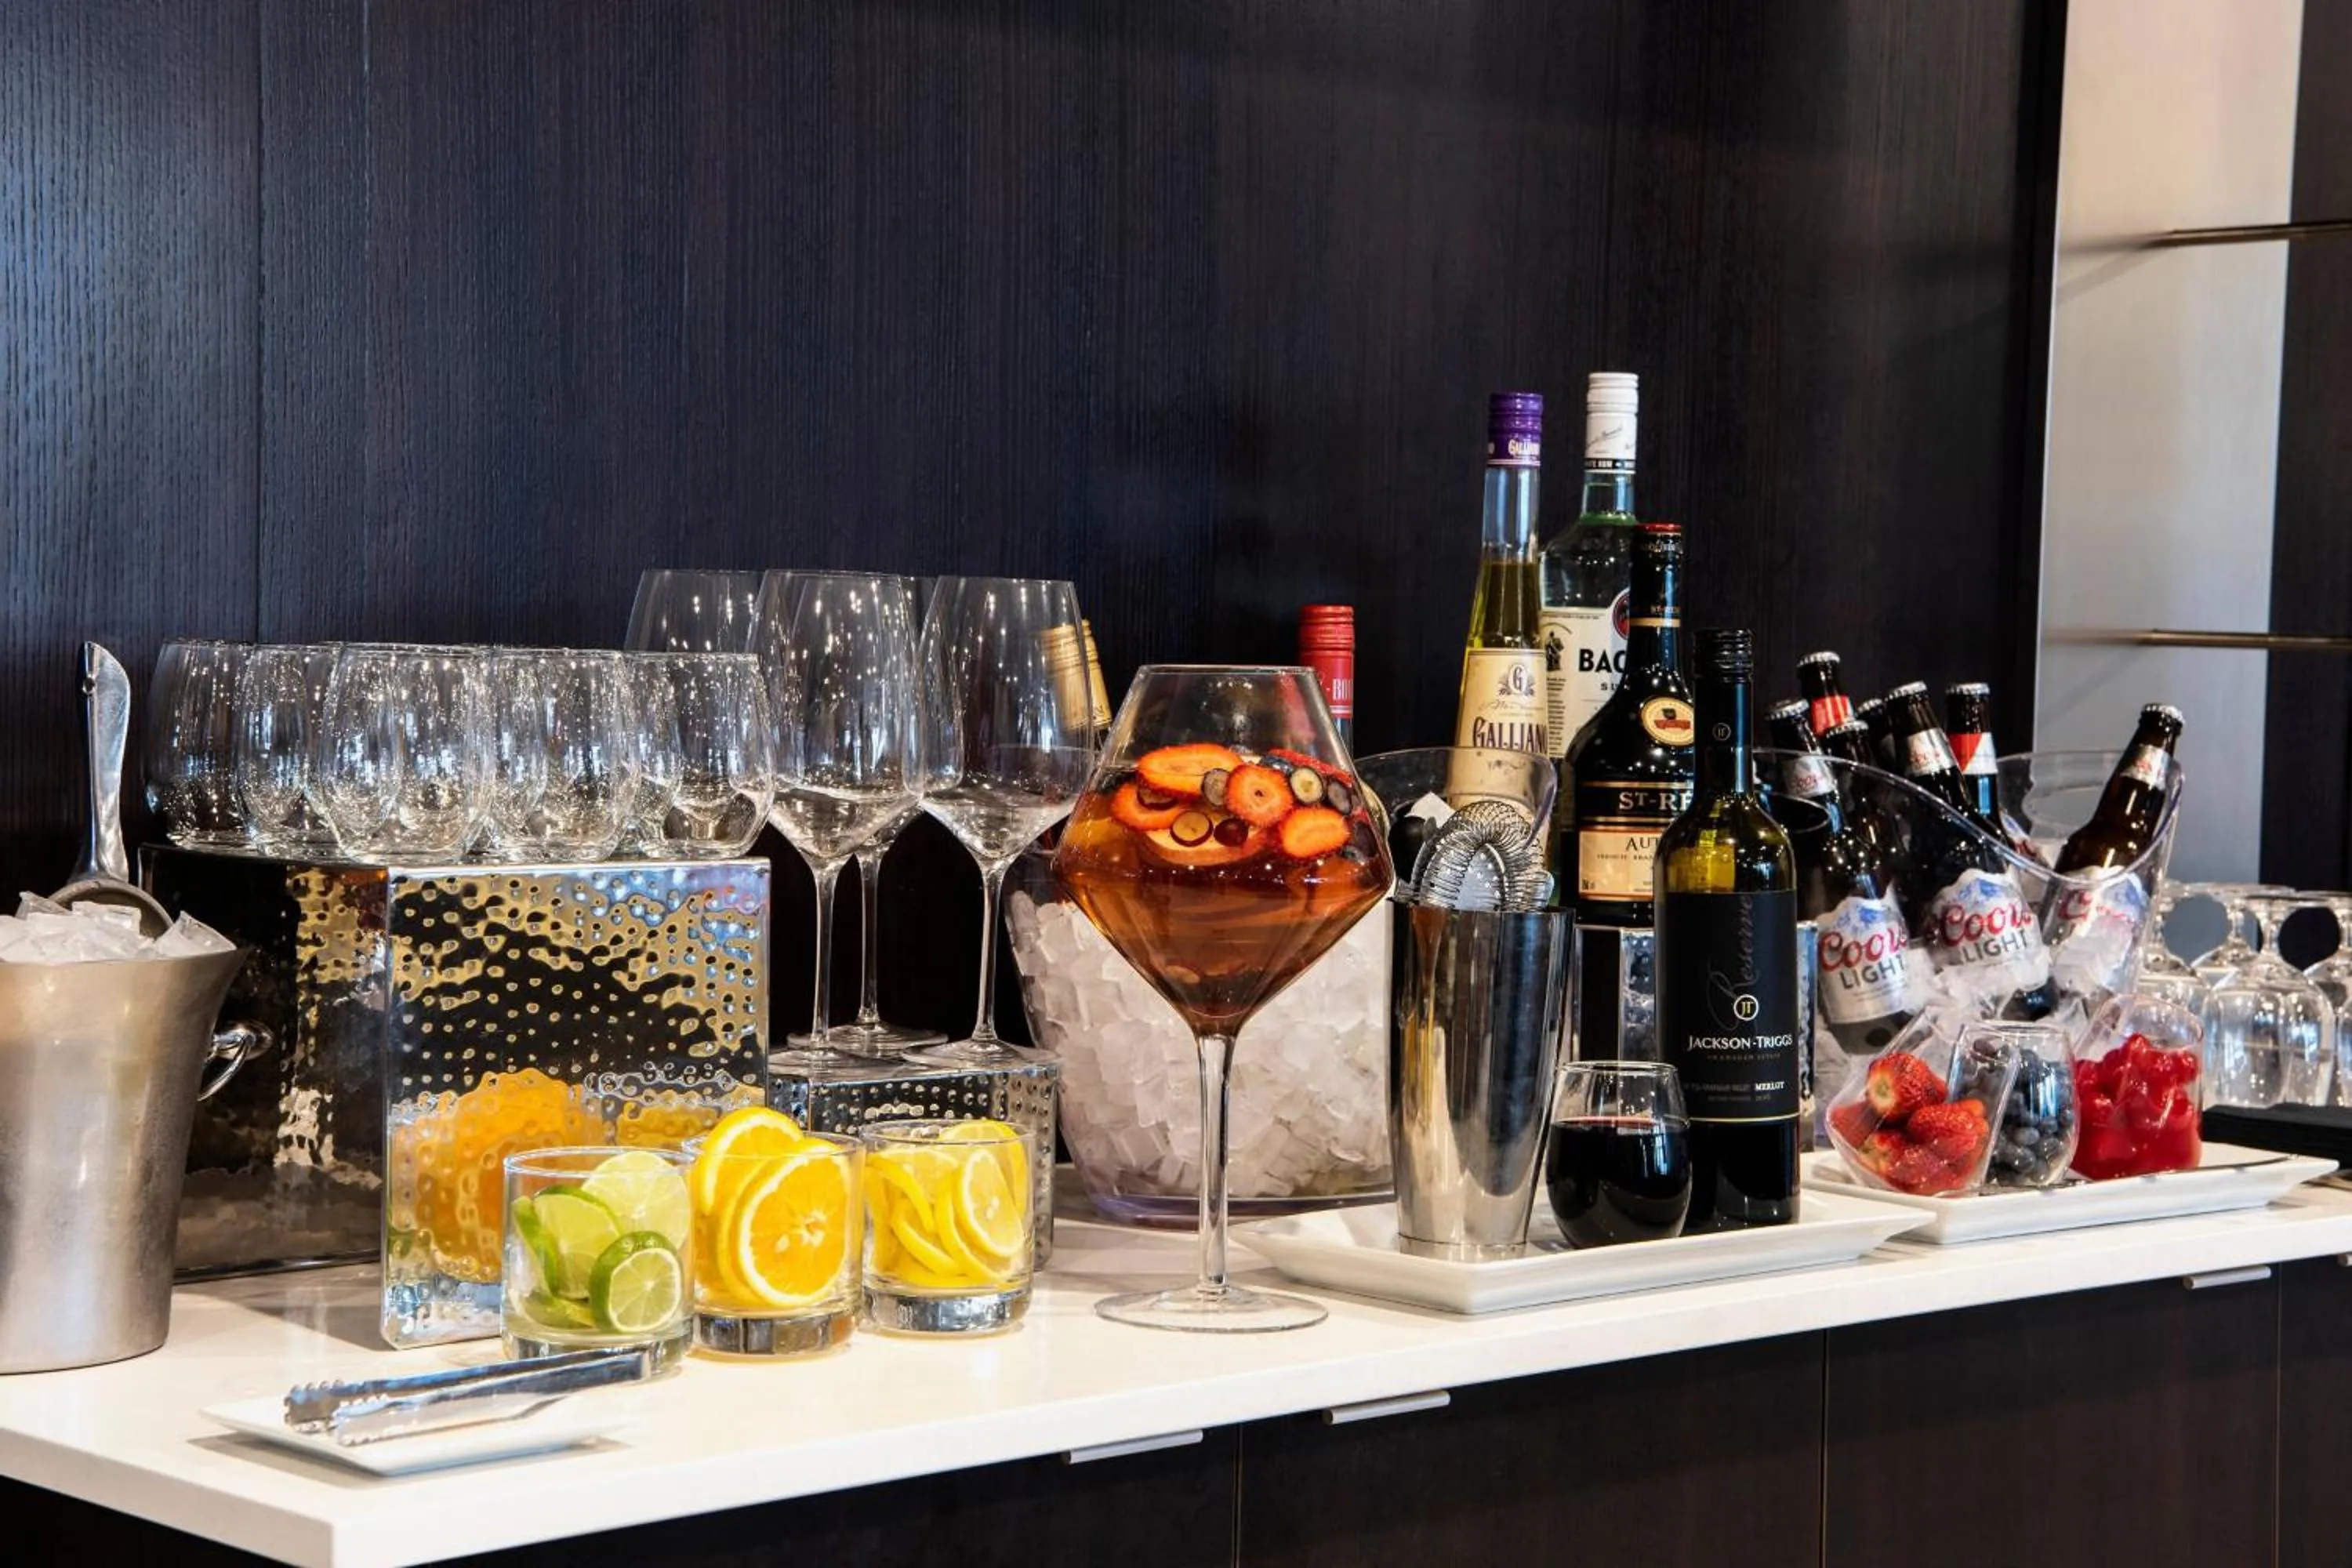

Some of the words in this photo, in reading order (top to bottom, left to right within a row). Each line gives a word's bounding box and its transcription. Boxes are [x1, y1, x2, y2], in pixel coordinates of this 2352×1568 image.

[1962, 928, 2027, 963] LIGHT
[1840, 954, 1905, 989] LIGHT
[1686, 1034, 1793, 1052] JACKSON-TRIGGS
[1755, 1081, 1785, 1091] MERLOT
